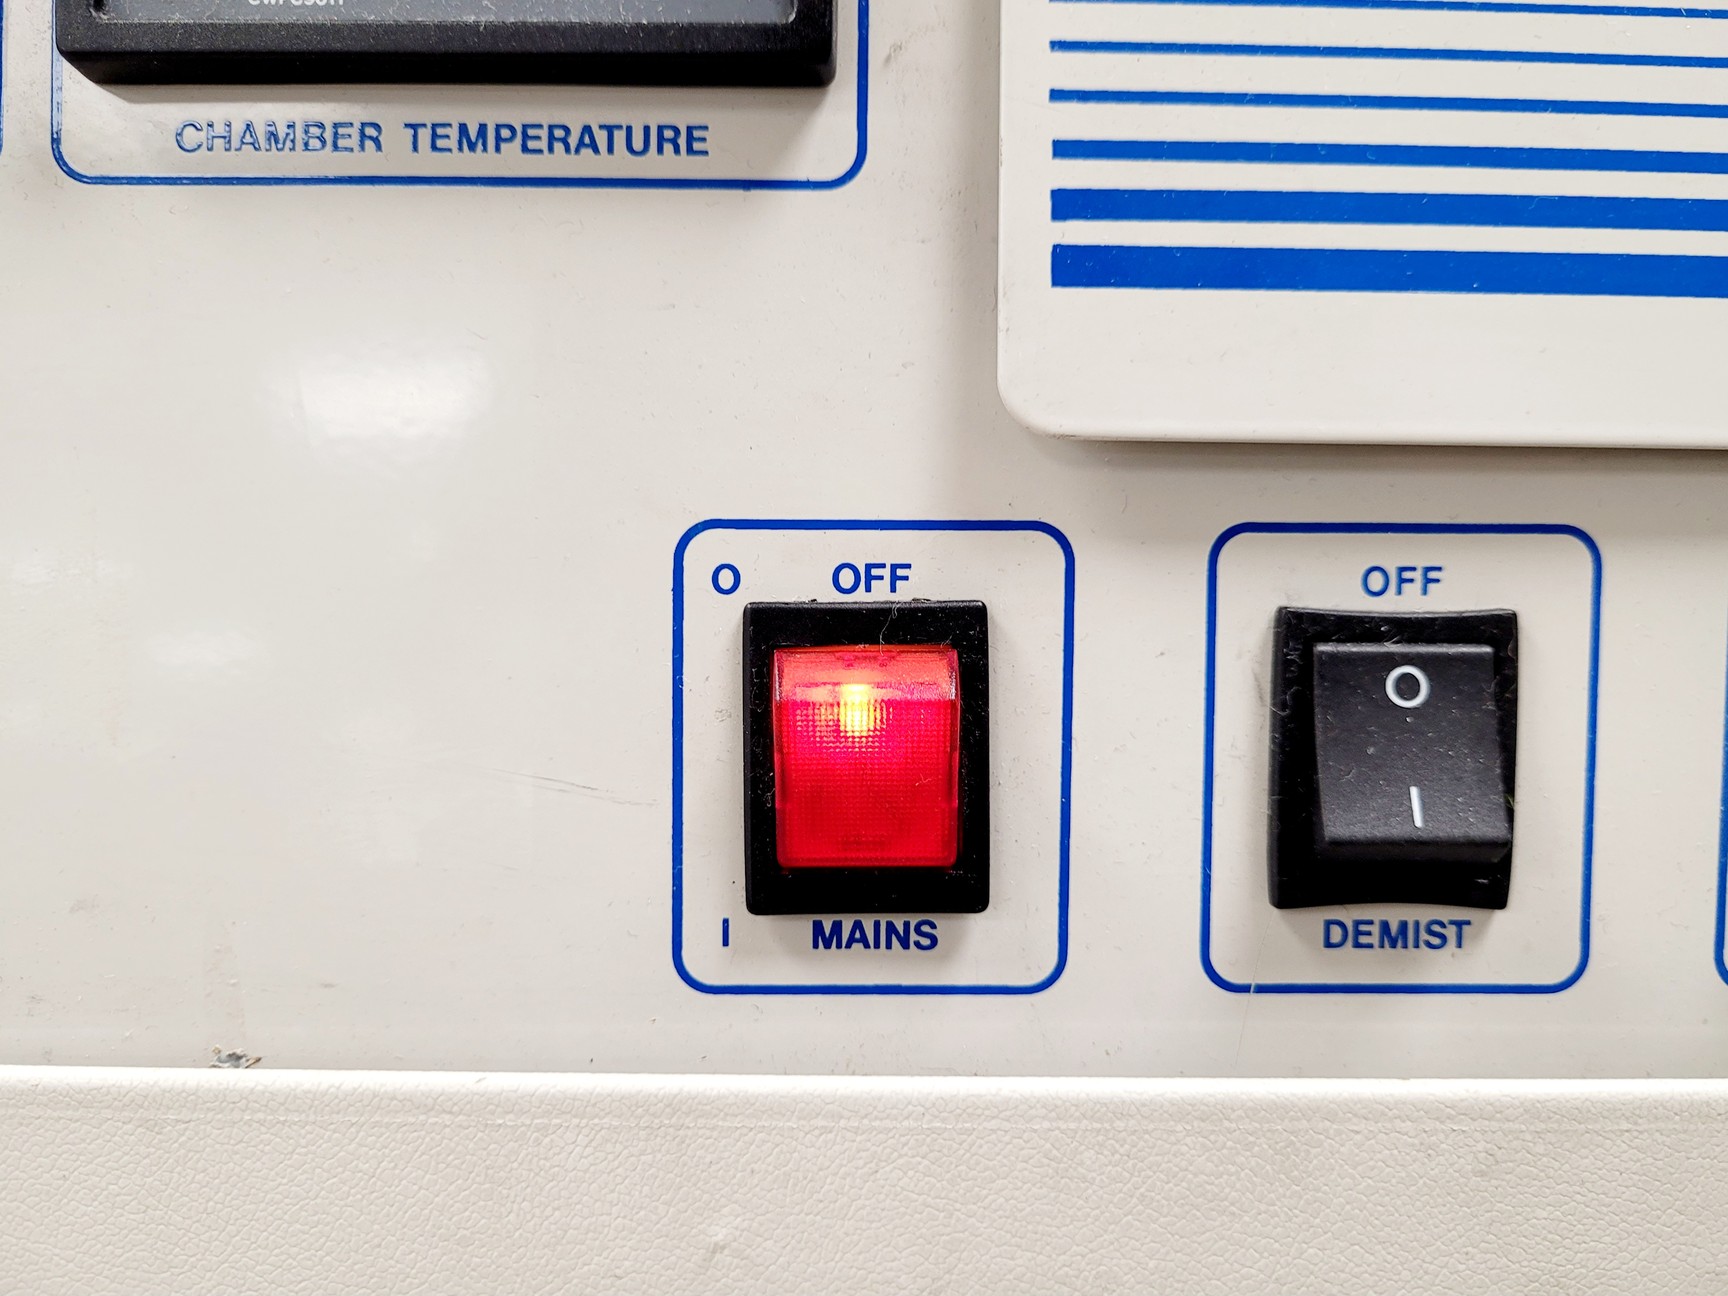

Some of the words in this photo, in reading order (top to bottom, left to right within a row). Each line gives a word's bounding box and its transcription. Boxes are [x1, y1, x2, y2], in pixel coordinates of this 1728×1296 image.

[175, 121, 382, 153] CHAMBER
[404, 122, 709, 157] TEMPERATURE
[832, 562, 912, 595] OFF
[1361, 565, 1443, 597] OFF
[812, 919, 938, 951] MAINS
[1323, 919, 1472, 950] DEMIST
